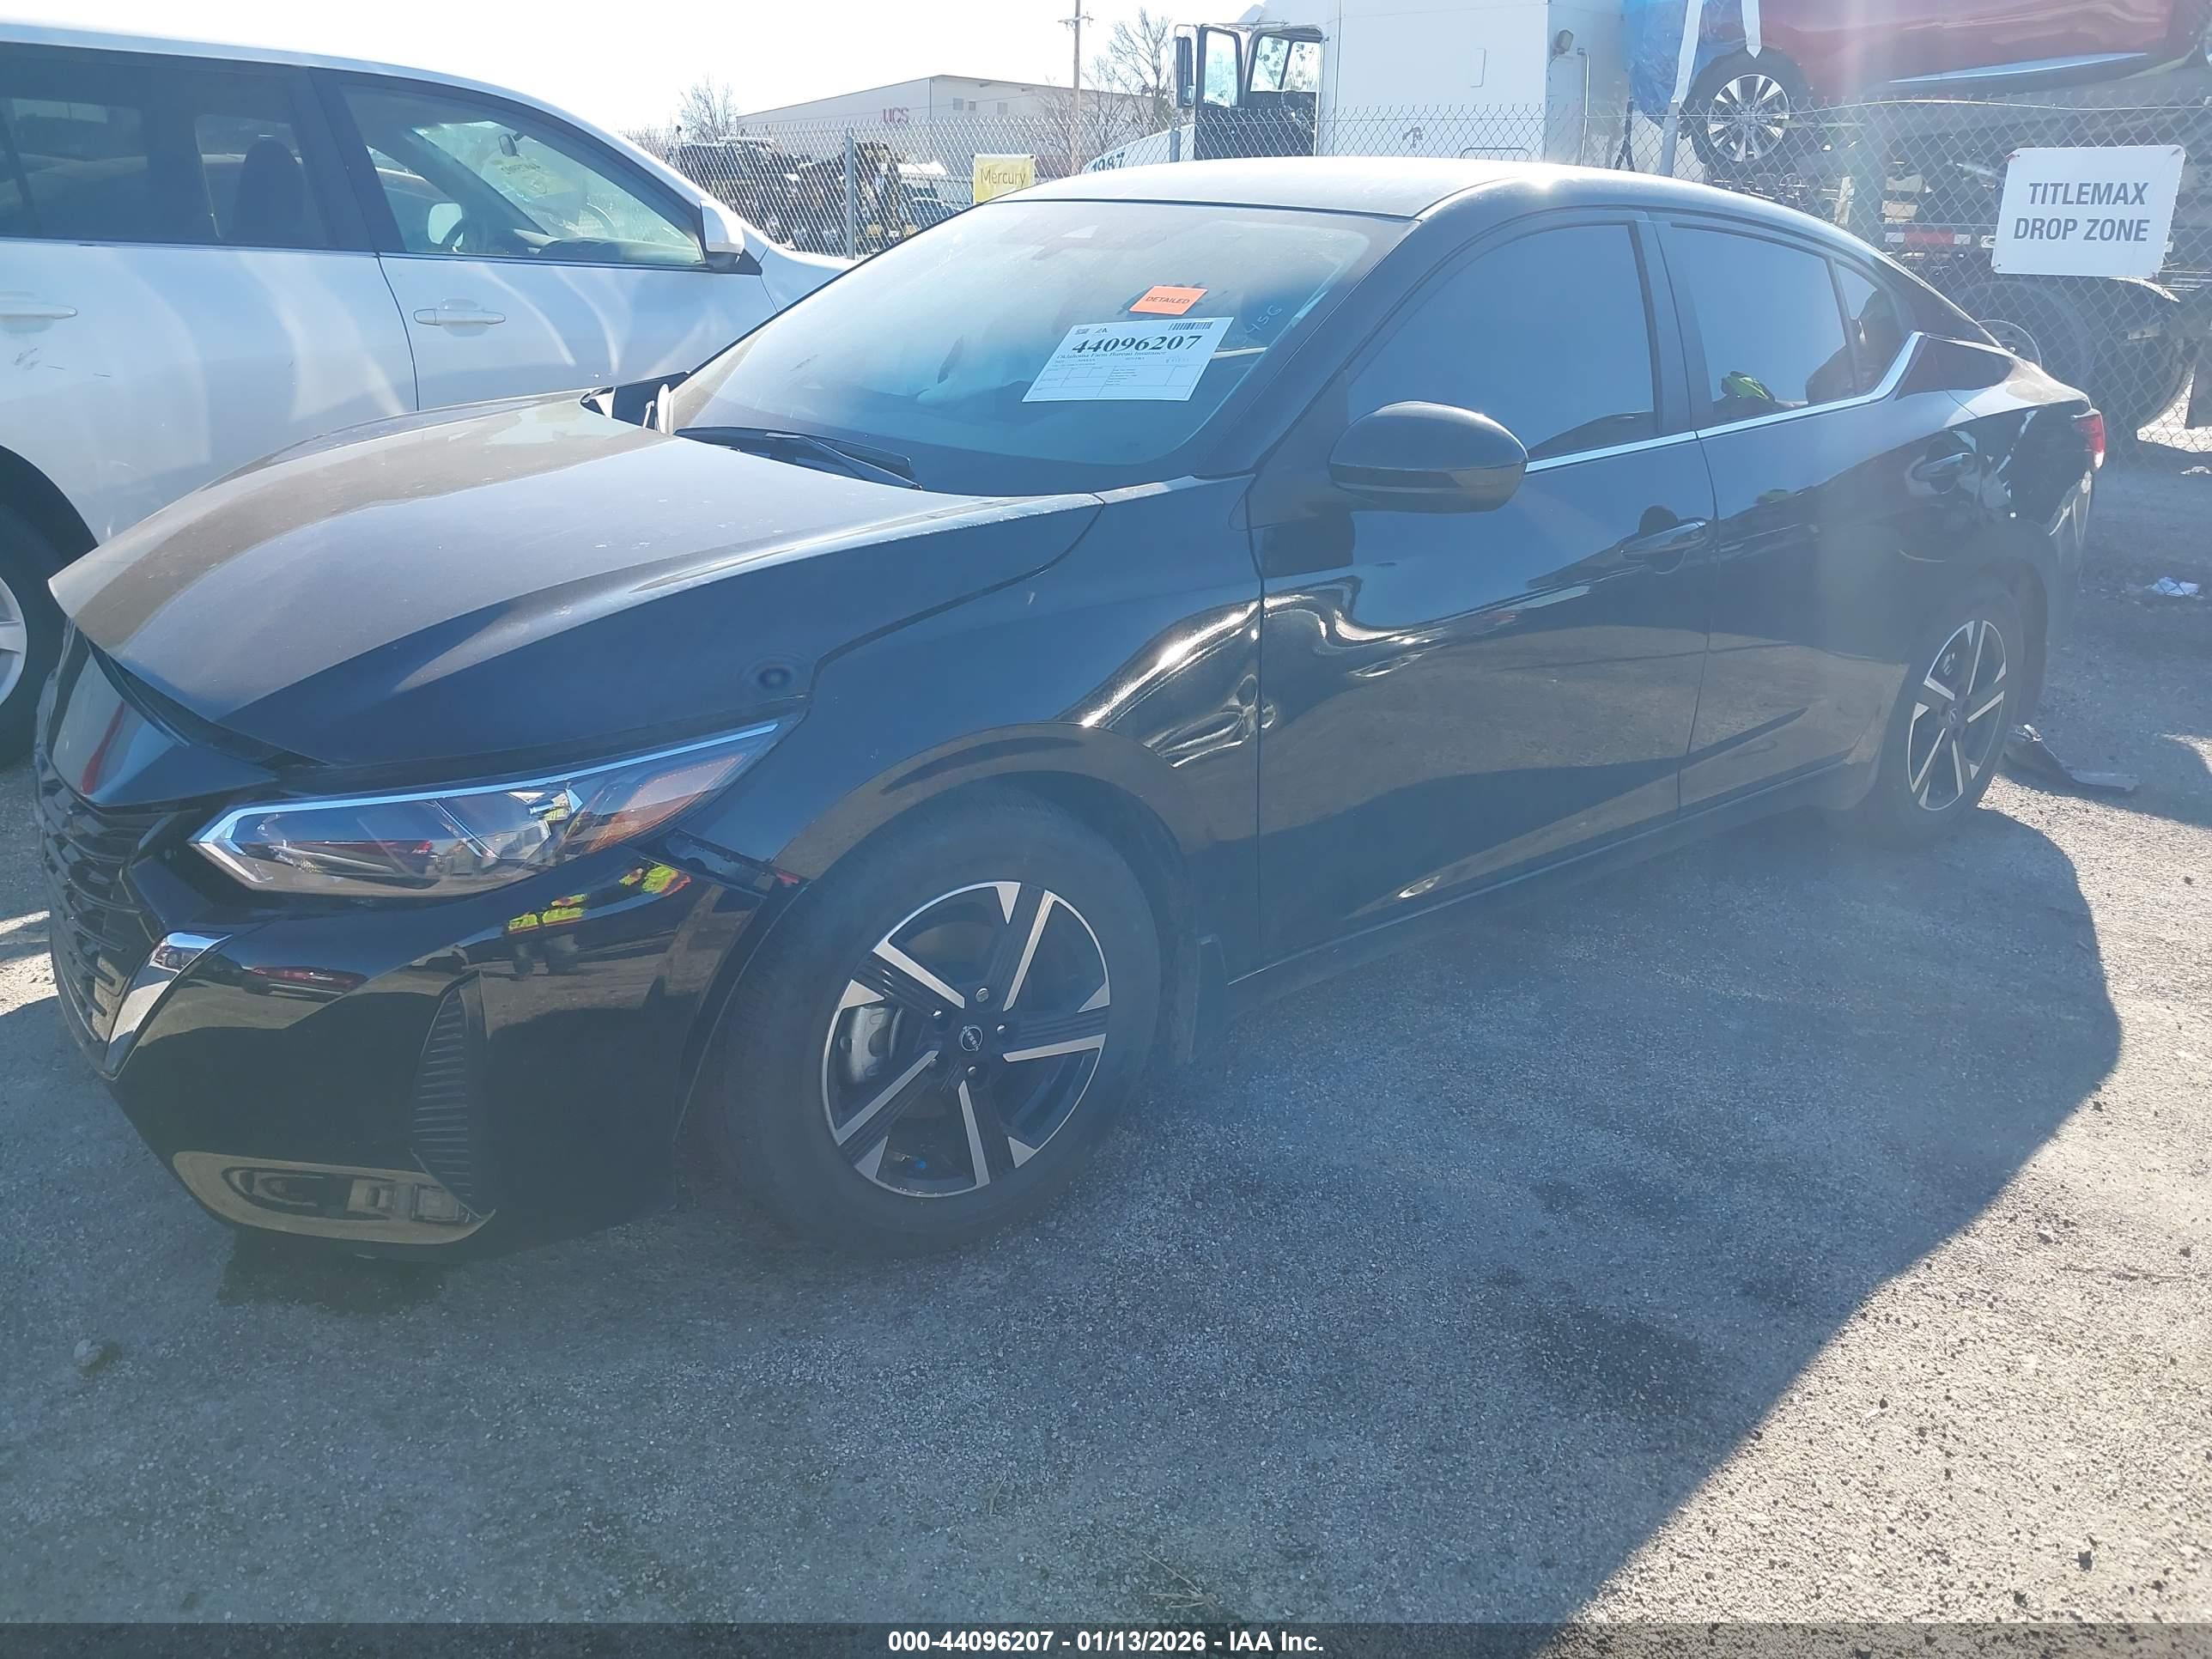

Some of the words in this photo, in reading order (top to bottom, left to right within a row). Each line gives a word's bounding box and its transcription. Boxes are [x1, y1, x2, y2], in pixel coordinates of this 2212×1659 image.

[981, 167, 1027, 186] Mercury
[2029, 181, 2149, 205] TITLEMAX
[2013, 216, 2078, 240] DROP
[2082, 218, 2151, 241] ZONE
[1145, 295, 1191, 305] DETAILED
[1072, 334, 1203, 354] 44096207
